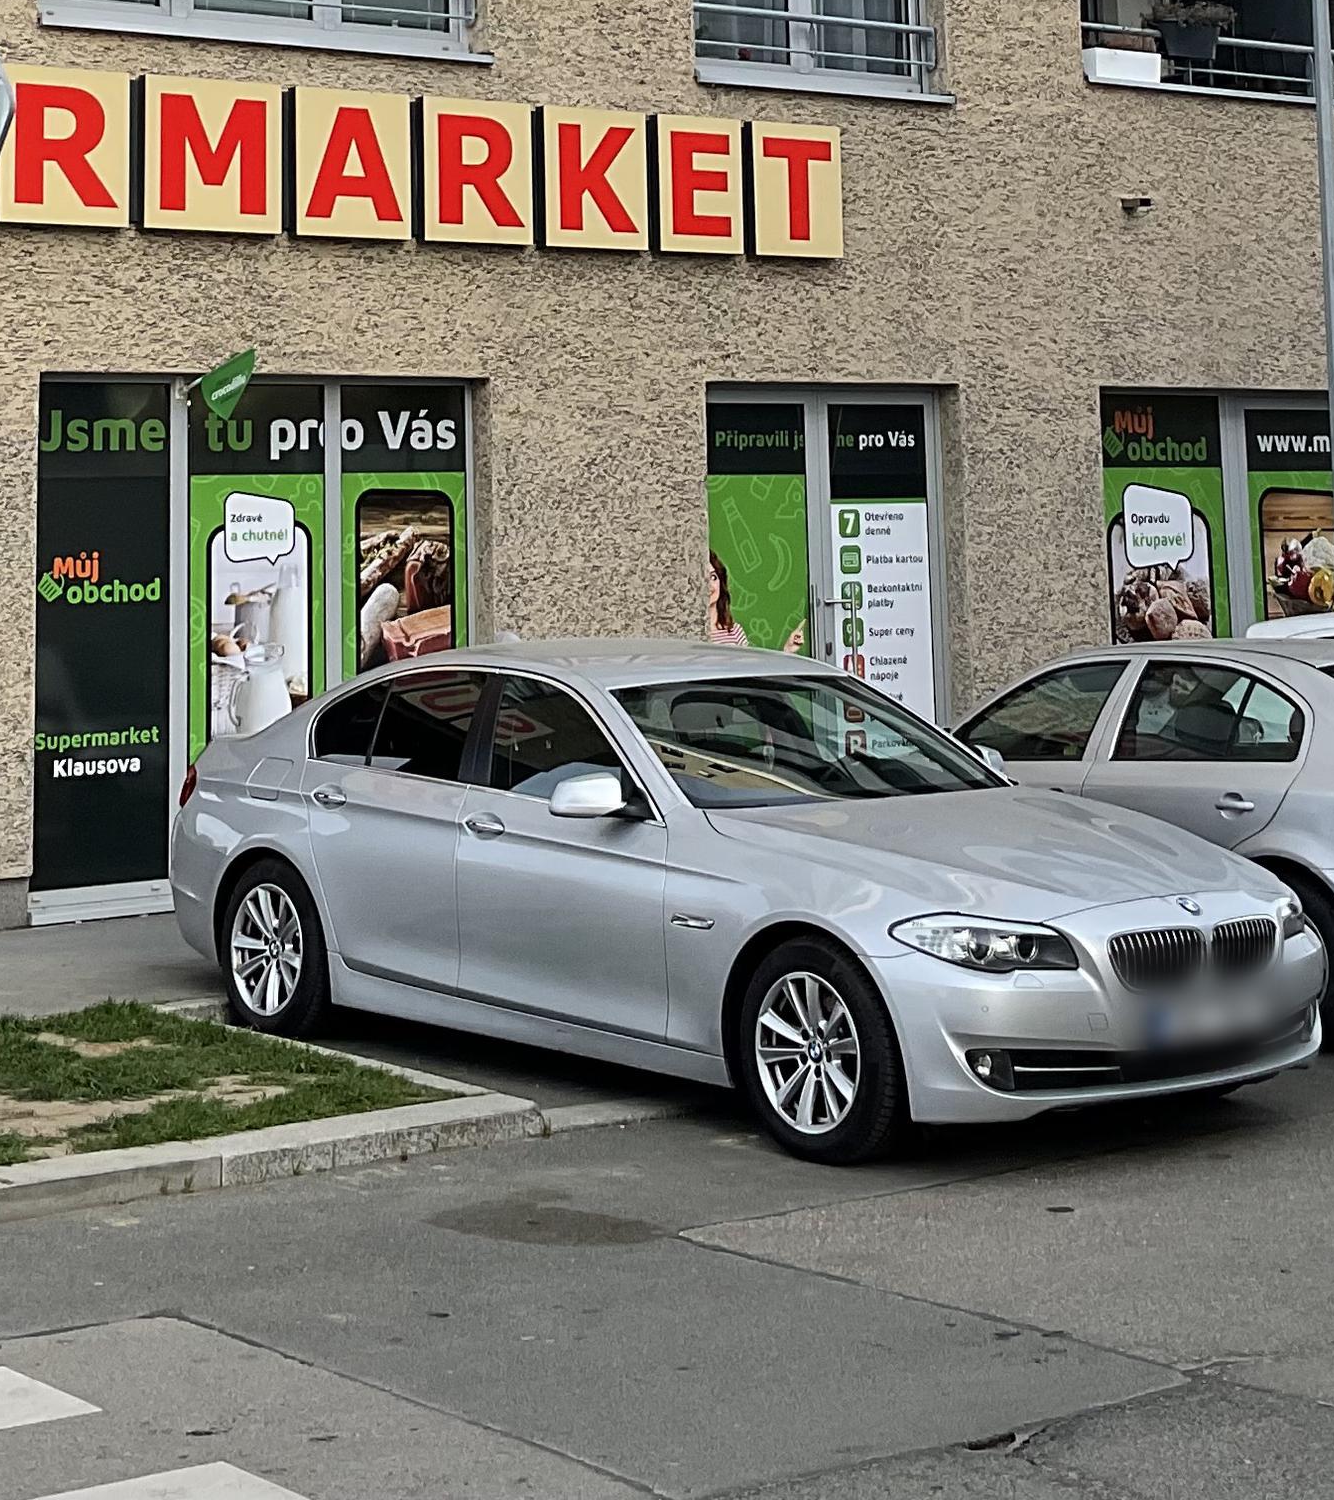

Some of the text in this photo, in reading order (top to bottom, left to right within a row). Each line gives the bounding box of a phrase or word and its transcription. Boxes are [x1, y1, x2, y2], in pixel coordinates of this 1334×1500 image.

[1114, 406, 1154, 439] Můj
[40, 409, 457, 461] Jsme tu pro Vás
[715, 430, 789, 451] Připravili
[858, 433, 885, 451] pro
[887, 430, 916, 448] Vás
[1127, 436, 1208, 462] obchod
[230, 513, 263, 523] Zdravé
[843, 512, 856, 534] 7
[1131, 513, 1171, 525] Opravdu
[230, 532, 238, 542] a
[1132, 531, 1187, 550] křupavé!
[53, 551, 100, 583] Můj
[866, 553, 924, 565] Platba kartou
[67, 577, 161, 604] obchod
[868, 598, 895, 609] platby
[868, 626, 915, 639] Super ceny
[869, 655, 908, 667] Chlazené
[870, 671, 899, 682] nápoje
[35, 726, 160, 753] Supermarket
[53, 757, 141, 779] Klausova
